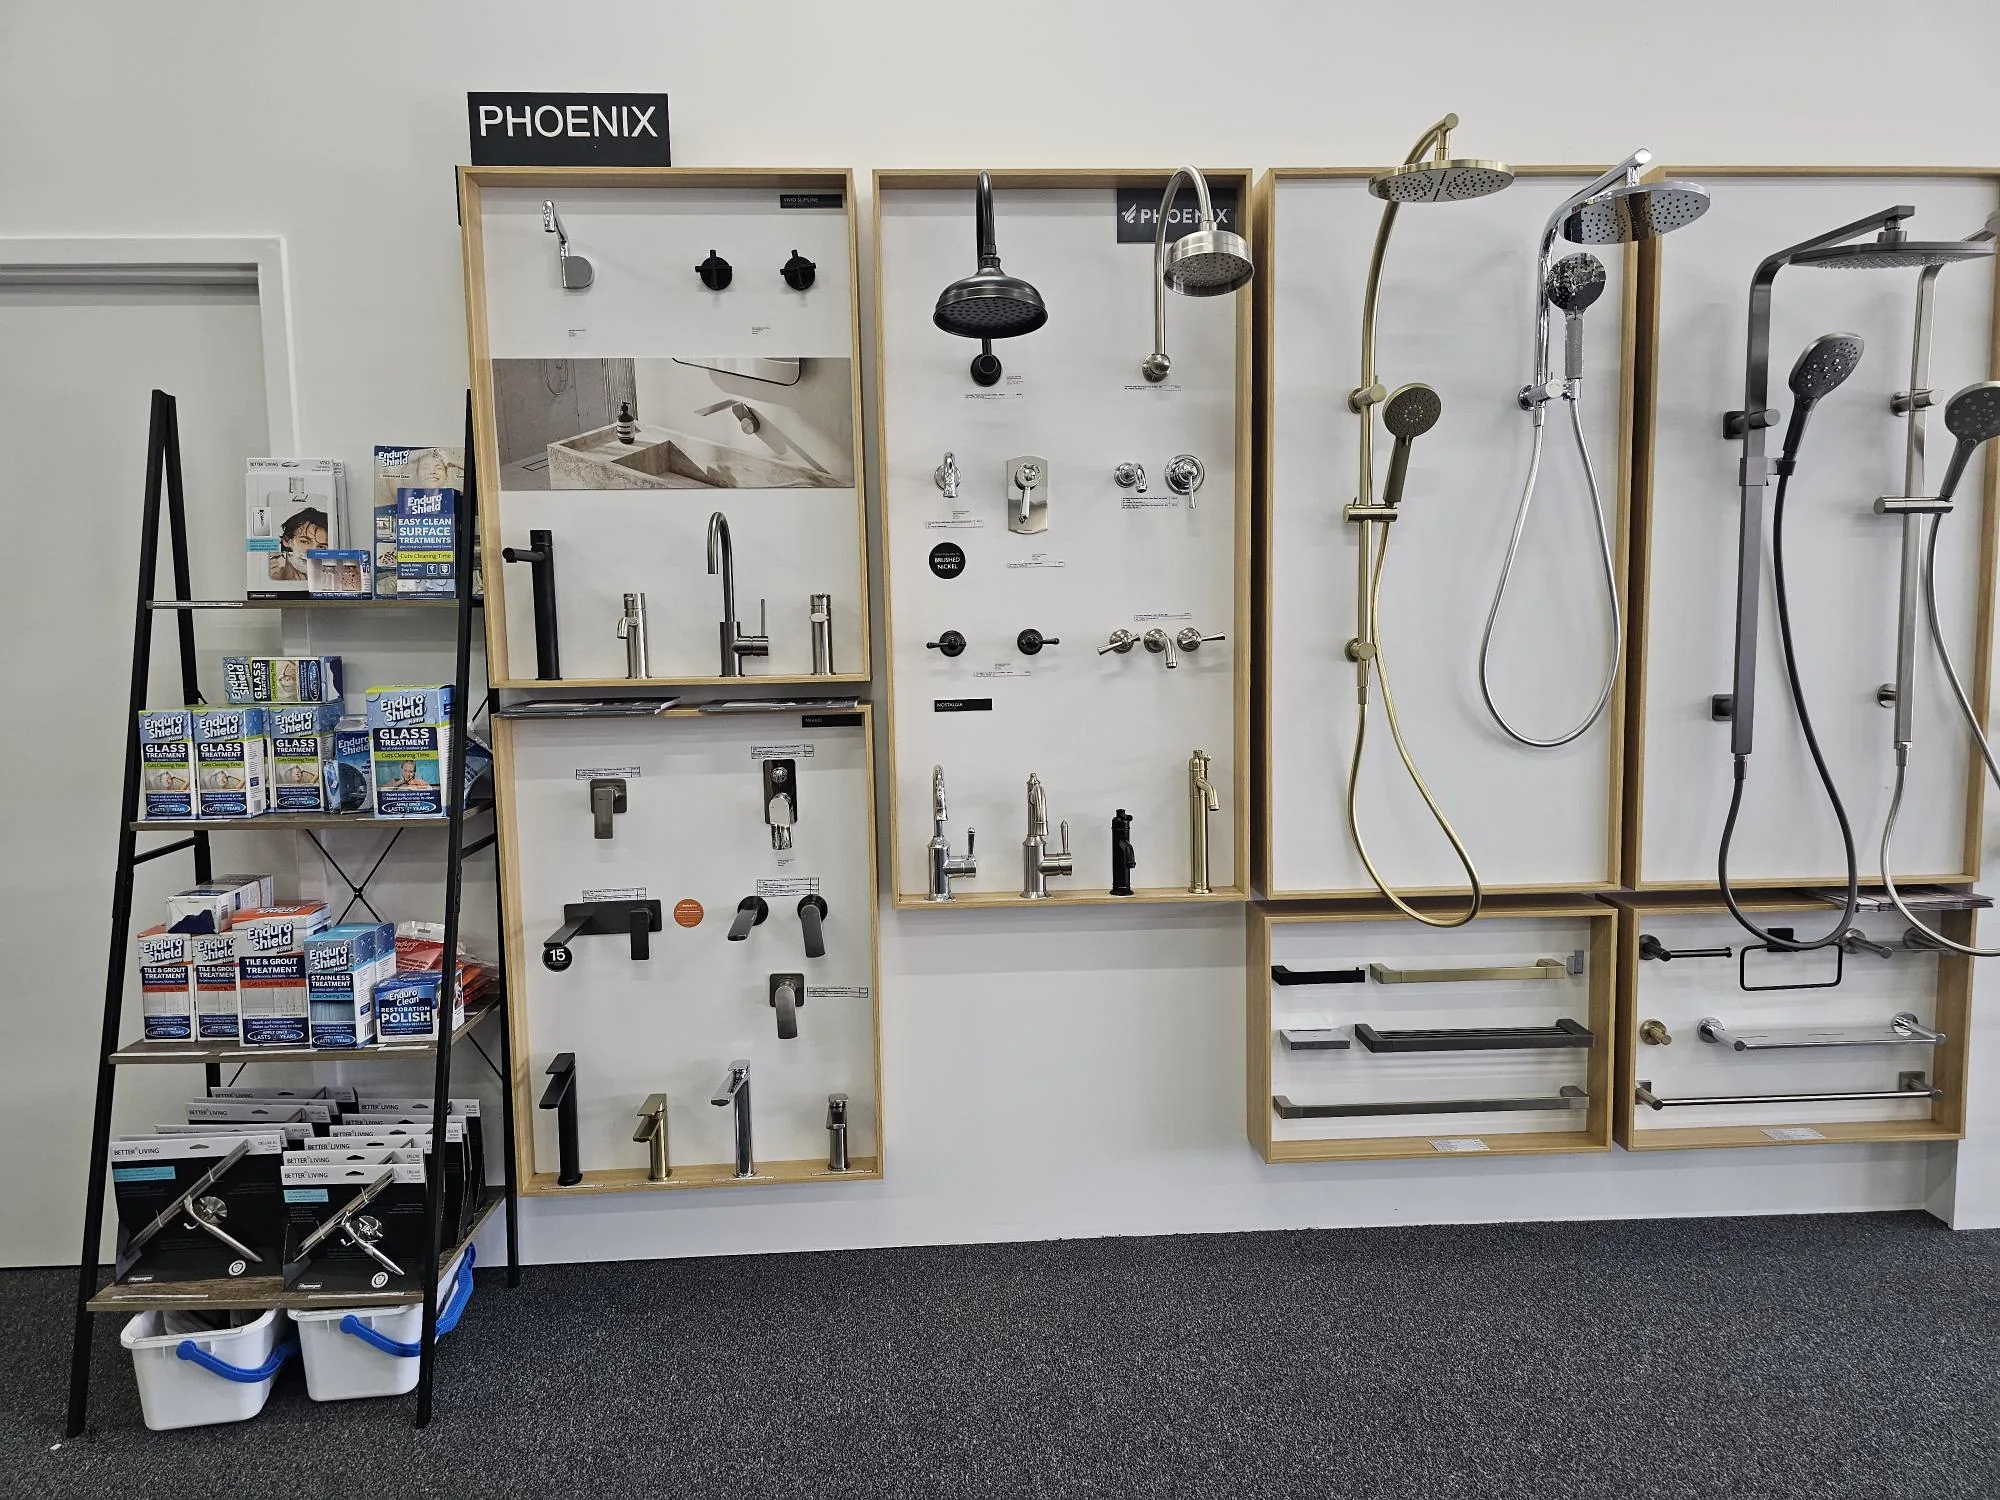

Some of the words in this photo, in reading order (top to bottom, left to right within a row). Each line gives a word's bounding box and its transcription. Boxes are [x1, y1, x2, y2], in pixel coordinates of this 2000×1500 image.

[479, 105, 658, 137] PHOENIX
[378, 450, 409, 460] Enduro
[382, 456, 408, 467] Shield
[408, 494, 442, 506] Enduro
[412, 502, 441, 514] Shield
[400, 528, 450, 536] SURFACE
[227, 663, 241, 699] Enduro
[235, 665, 249, 695] Shield
[254, 662, 262, 698] GLASS
[380, 694, 424, 711] Enduro
[275, 711, 313, 725] Enduro
[385, 704, 423, 722] Shield
[144, 716, 183, 730] Enduro
[201, 714, 239, 729] Enduro
[280, 721, 312, 735] Shield
[149, 724, 182, 739] Shield
[204, 724, 238, 739] Shield
[380, 728, 430, 739] GLASS
[146, 744, 186, 752] GLASS
[200, 743, 241, 752] GLASS
[247, 922, 292, 940] Enduro
[144, 939, 183, 952] Enduro
[253, 932, 291, 951] Shield
[148, 947, 182, 962] Shield
[310, 945, 348, 961] Enduro
[550, 949, 565, 961] 15
[314, 956, 347, 970] Shield
[390, 990, 417, 1000] Enduro
[396, 997, 419, 1006] Clean
[382, 1012, 430, 1022] POLISH
